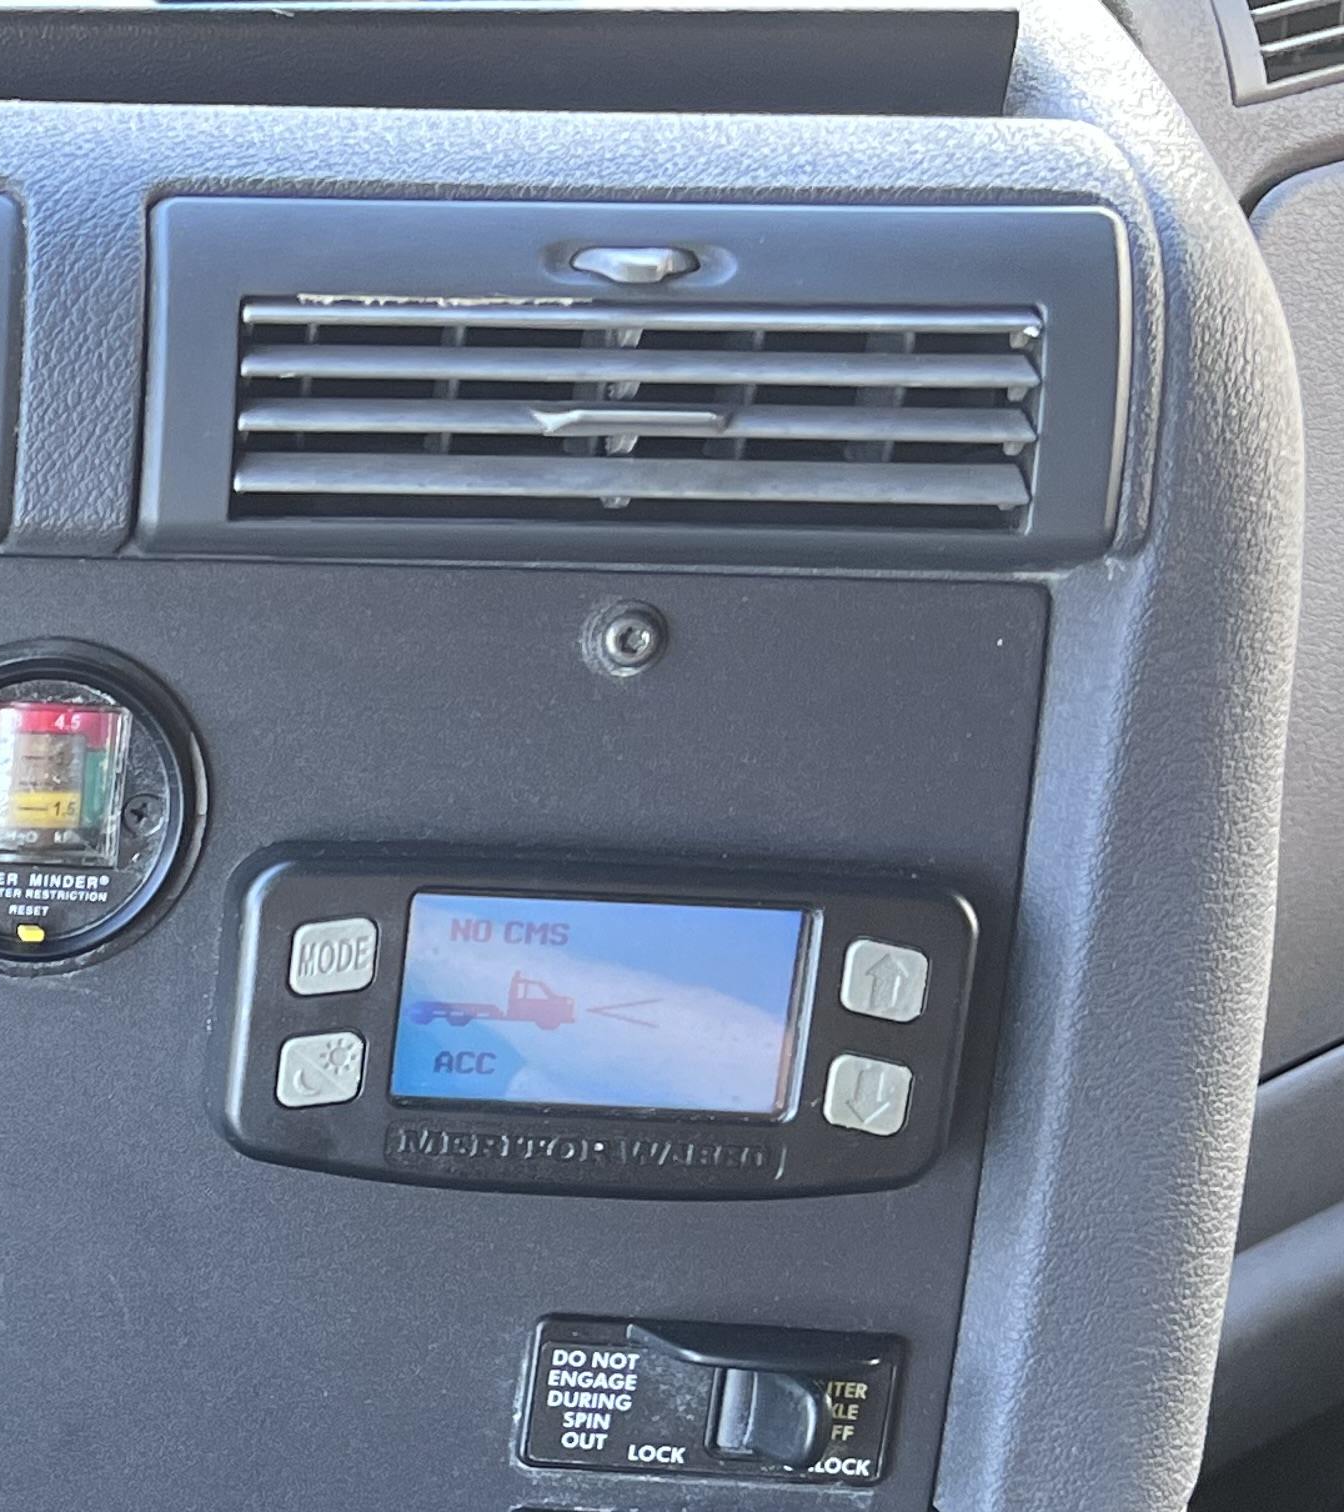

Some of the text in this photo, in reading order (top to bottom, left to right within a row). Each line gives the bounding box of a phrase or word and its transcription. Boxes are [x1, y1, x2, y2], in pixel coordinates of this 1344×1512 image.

[54, 801, 76, 816] 1.5
[25, 889, 108, 902] RESTRICTION
[9, 904, 50, 916] RESET
[449, 918, 570, 946] NO CMS
[297, 936, 370, 977] MODE
[433, 1051, 497, 1074] ACC
[552, 1349, 640, 1369] DO NOT
[548, 1370, 638, 1391] ENGAGE
[547, 1390, 633, 1411] DURING
[563, 1412, 611, 1431] SPIN
[561, 1432, 608, 1450] OUT
[628, 1444, 686, 1464] LOCK
